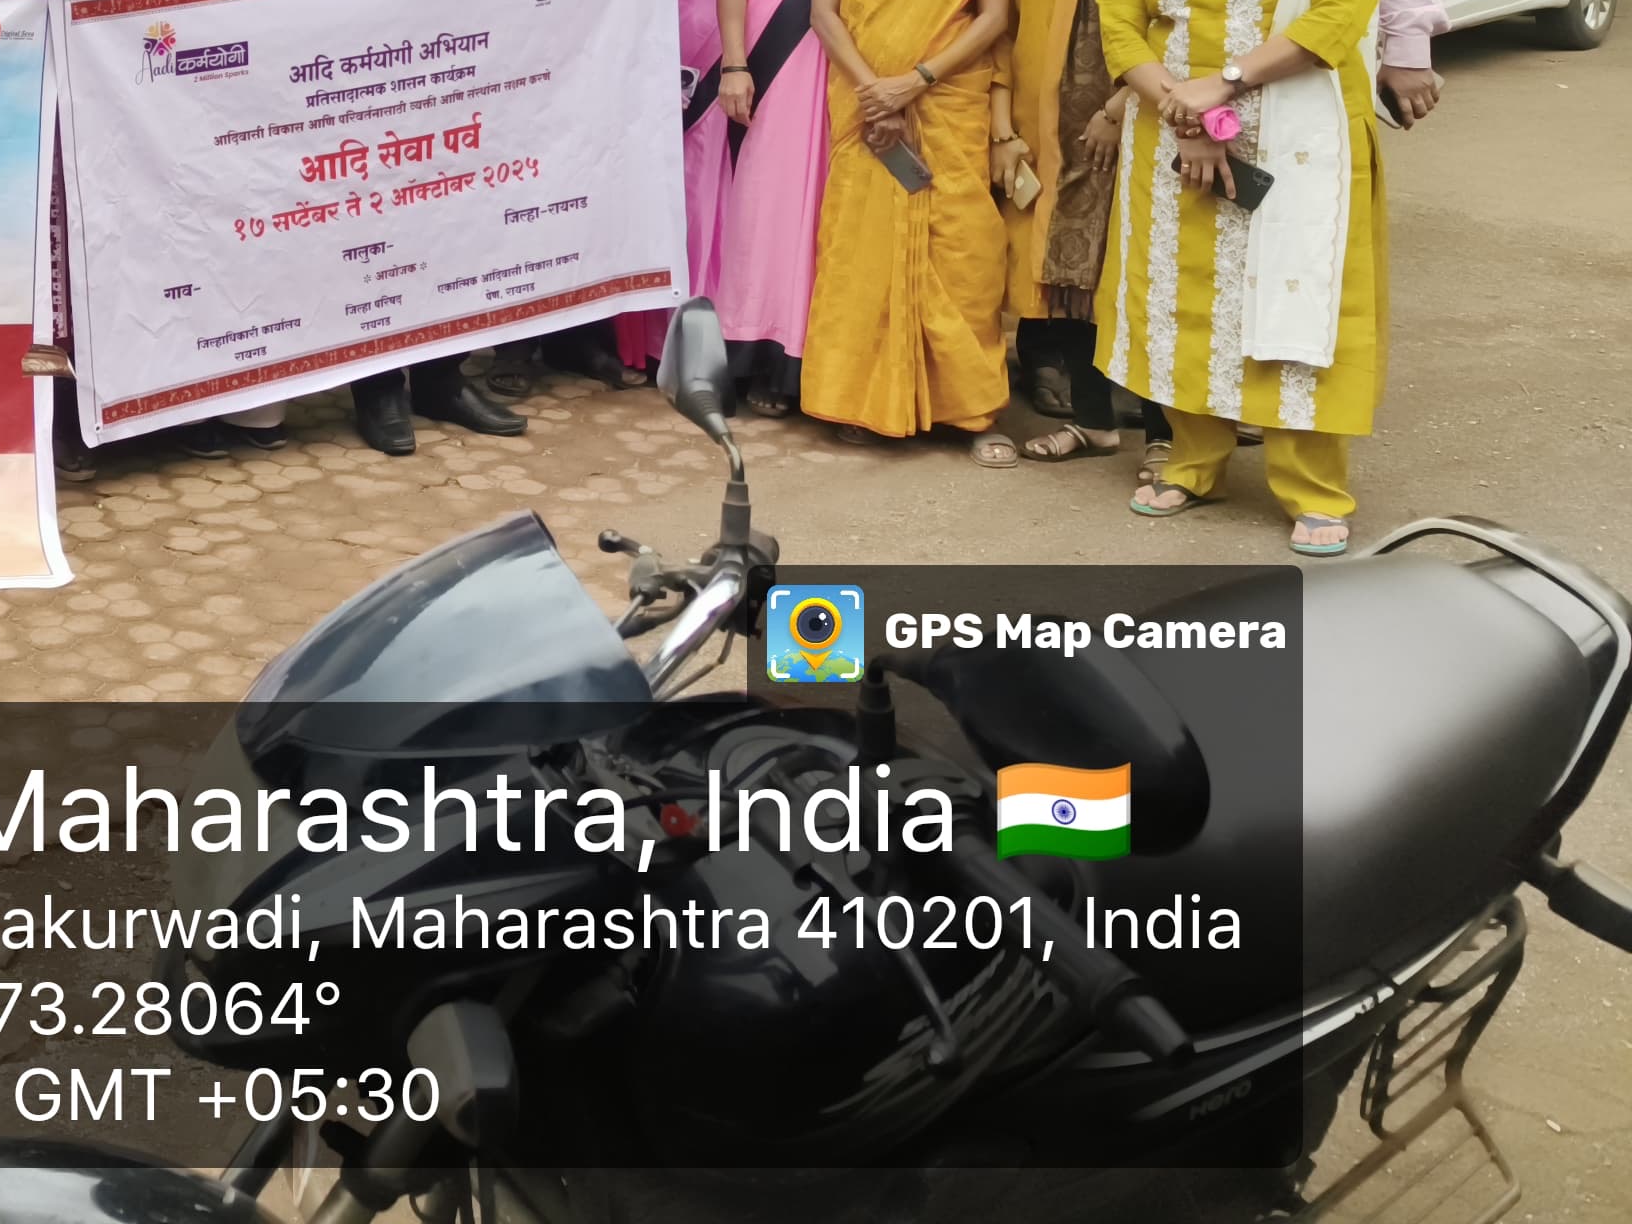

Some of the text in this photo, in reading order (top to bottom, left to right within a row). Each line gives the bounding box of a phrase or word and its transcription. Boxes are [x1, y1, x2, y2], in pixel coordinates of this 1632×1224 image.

[178, 45, 246, 71] कर्मयोगी
[289, 31, 489, 83] आदि कर्मयोगी अभियान
[305, 64, 476, 107] प्रतिसादात्मक शासन कार्यक्रम
[213, 126, 265, 147] आदिवासी
[269, 121, 304, 138] विकास
[308, 114, 335, 129] आणि
[440, 88, 463, 104] आणि
[299, 112, 482, 184] आदि सेवा पर्व
[234, 157, 539, 241] १७ सप्टेंबर ते २ ऑक्टोबर २०२५
[342, 240, 394, 263] तालुका-
[375, 262, 416, 281] आयोजक
[437, 276, 478, 294] एकात्मिक
[481, 264, 522, 283] आदिवासी
[163, 284, 201, 300] गाव-
[345, 302, 371, 317] जिल्हा
[197, 326, 258, 351] जिल्हाधिकारी
